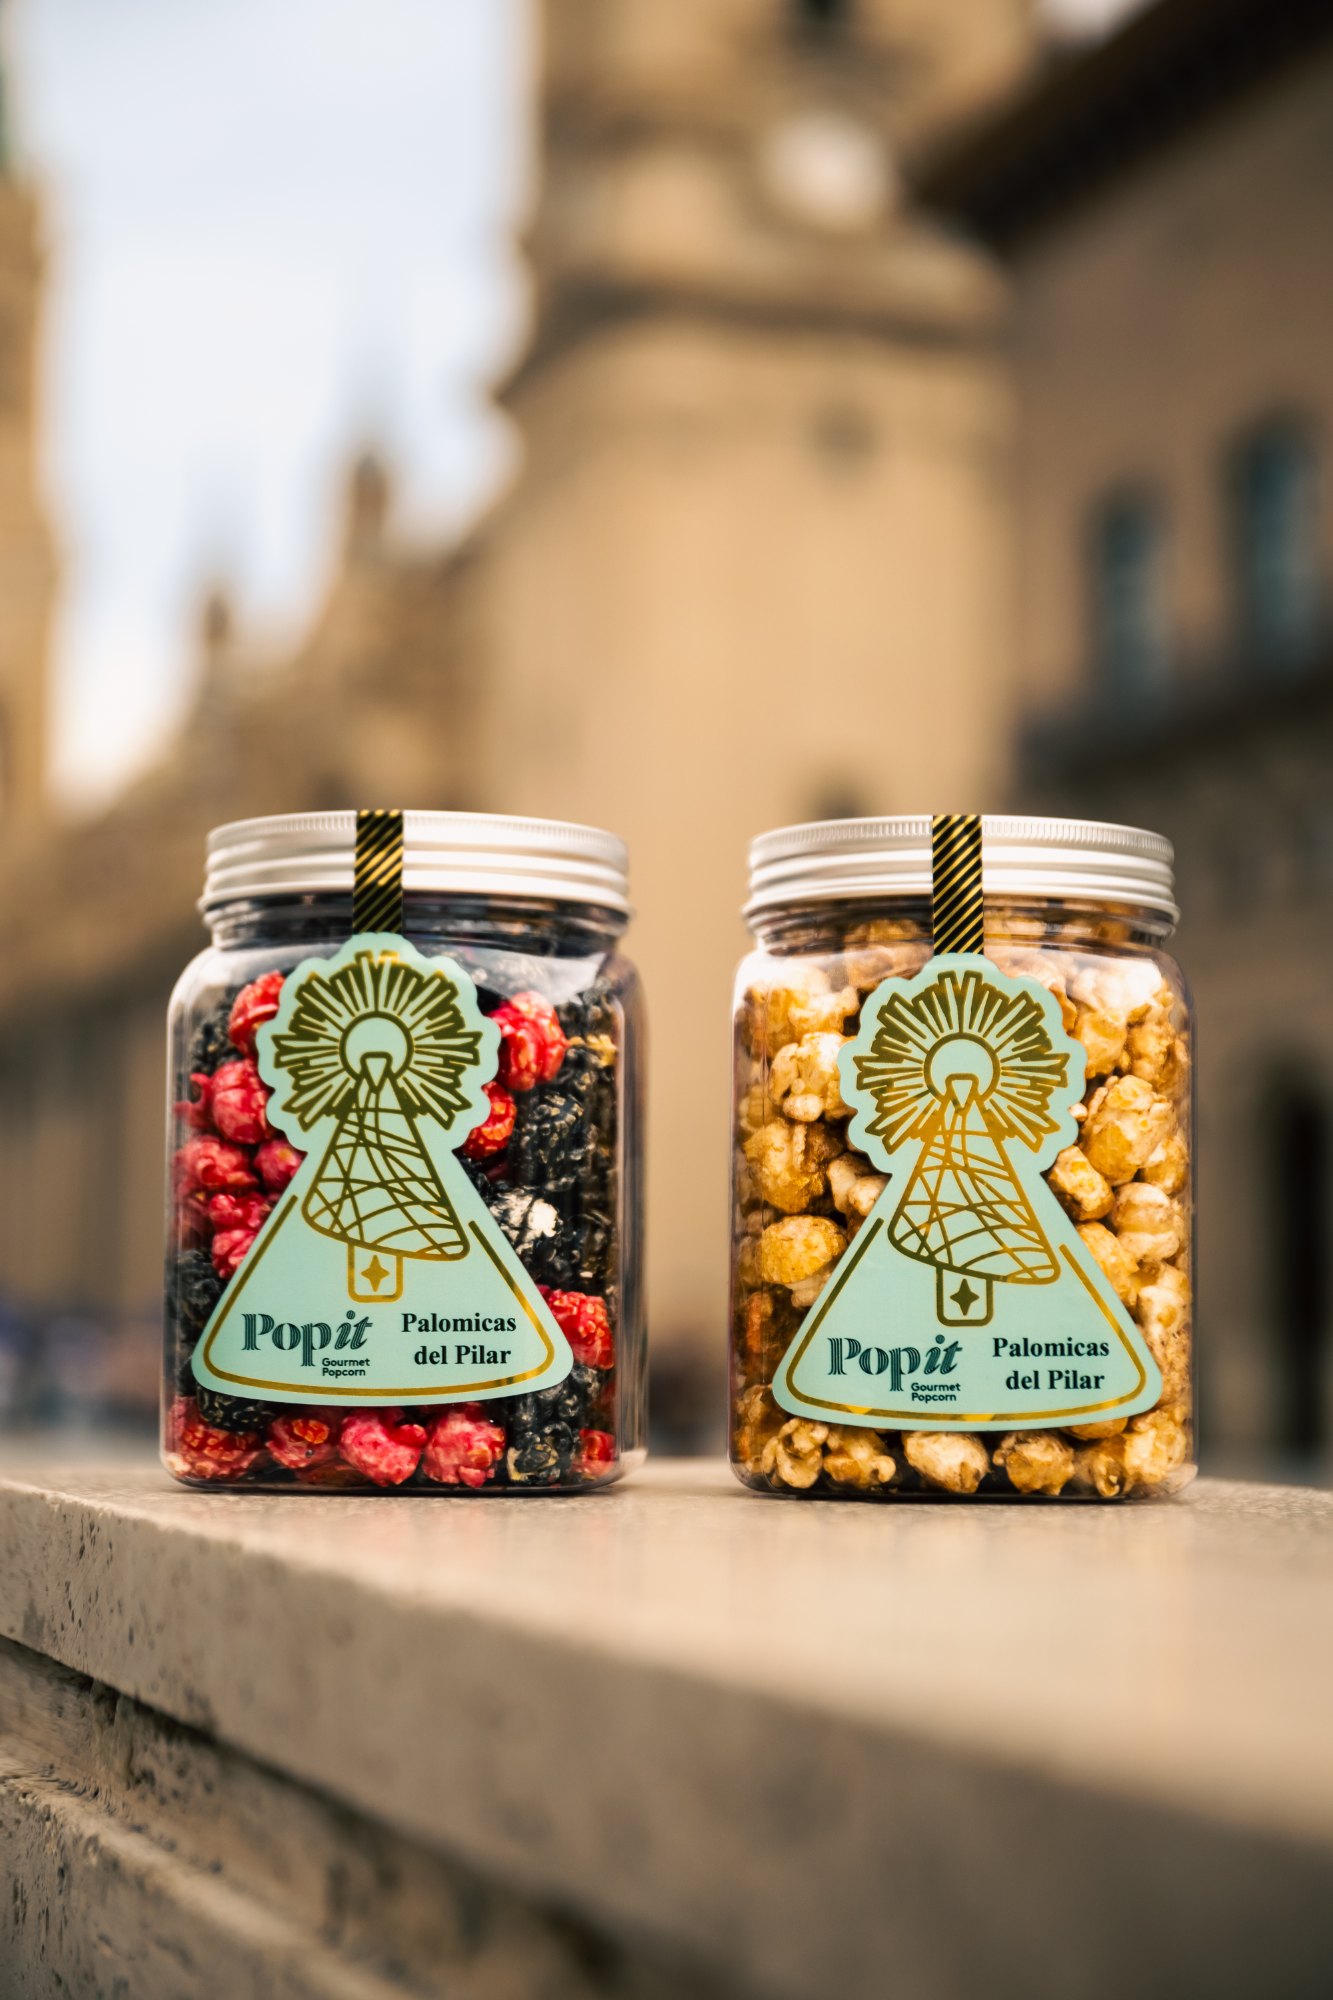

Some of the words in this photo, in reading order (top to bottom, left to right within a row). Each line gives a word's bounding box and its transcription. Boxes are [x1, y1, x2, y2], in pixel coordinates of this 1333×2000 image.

[401, 1312, 517, 1333] Palomicas
[241, 1310, 373, 1367] Popit
[992, 1337, 1110, 1358] Palomicas
[321, 1357, 371, 1368] Gourmet
[413, 1346, 447, 1365] del
[455, 1345, 512, 1365] Pilar
[827, 1334, 963, 1392] Popit
[321, 1367, 367, 1379] Popcorn
[1005, 1371, 1040, 1390] del
[1047, 1370, 1106, 1390] Pilar
[910, 1382, 961, 1393] Gourmet
[910, 1392, 957, 1404] Popcorn
